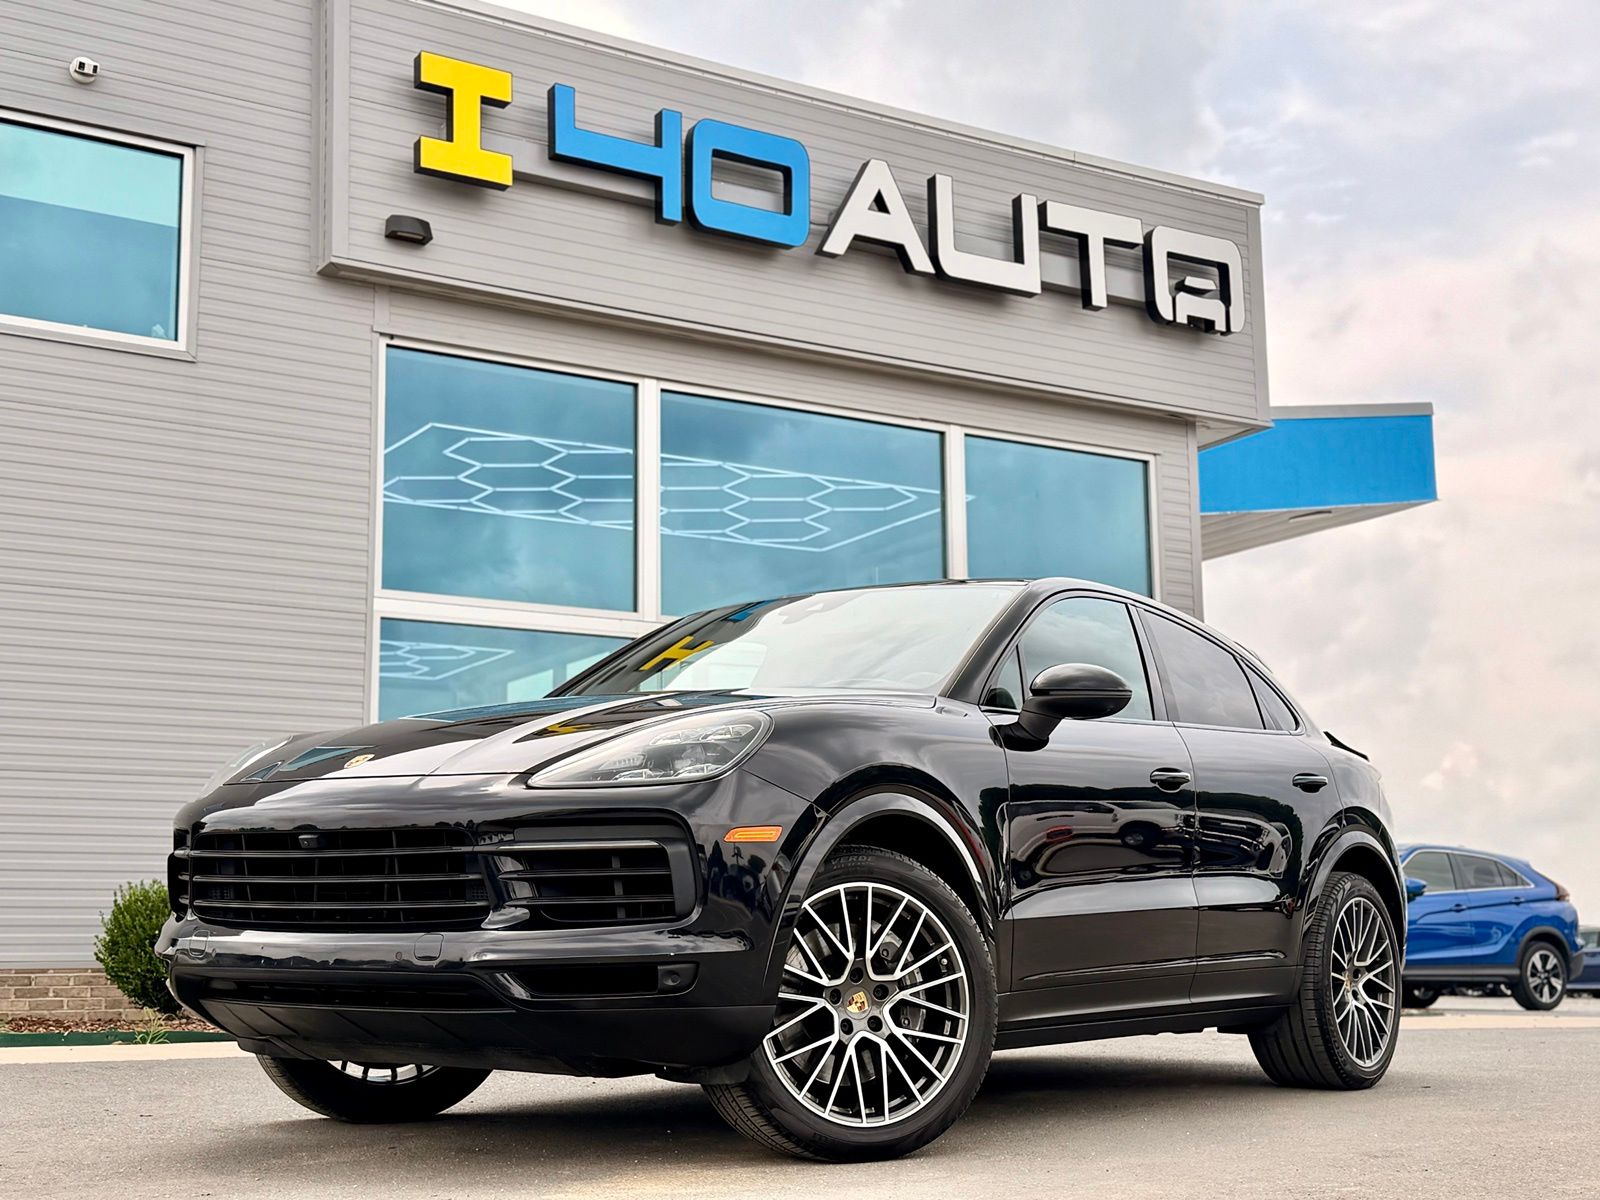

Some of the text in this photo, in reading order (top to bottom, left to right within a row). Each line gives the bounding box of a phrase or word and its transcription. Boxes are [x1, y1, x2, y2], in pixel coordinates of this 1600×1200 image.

[414, 51, 1245, 335] I 40 AUTO
